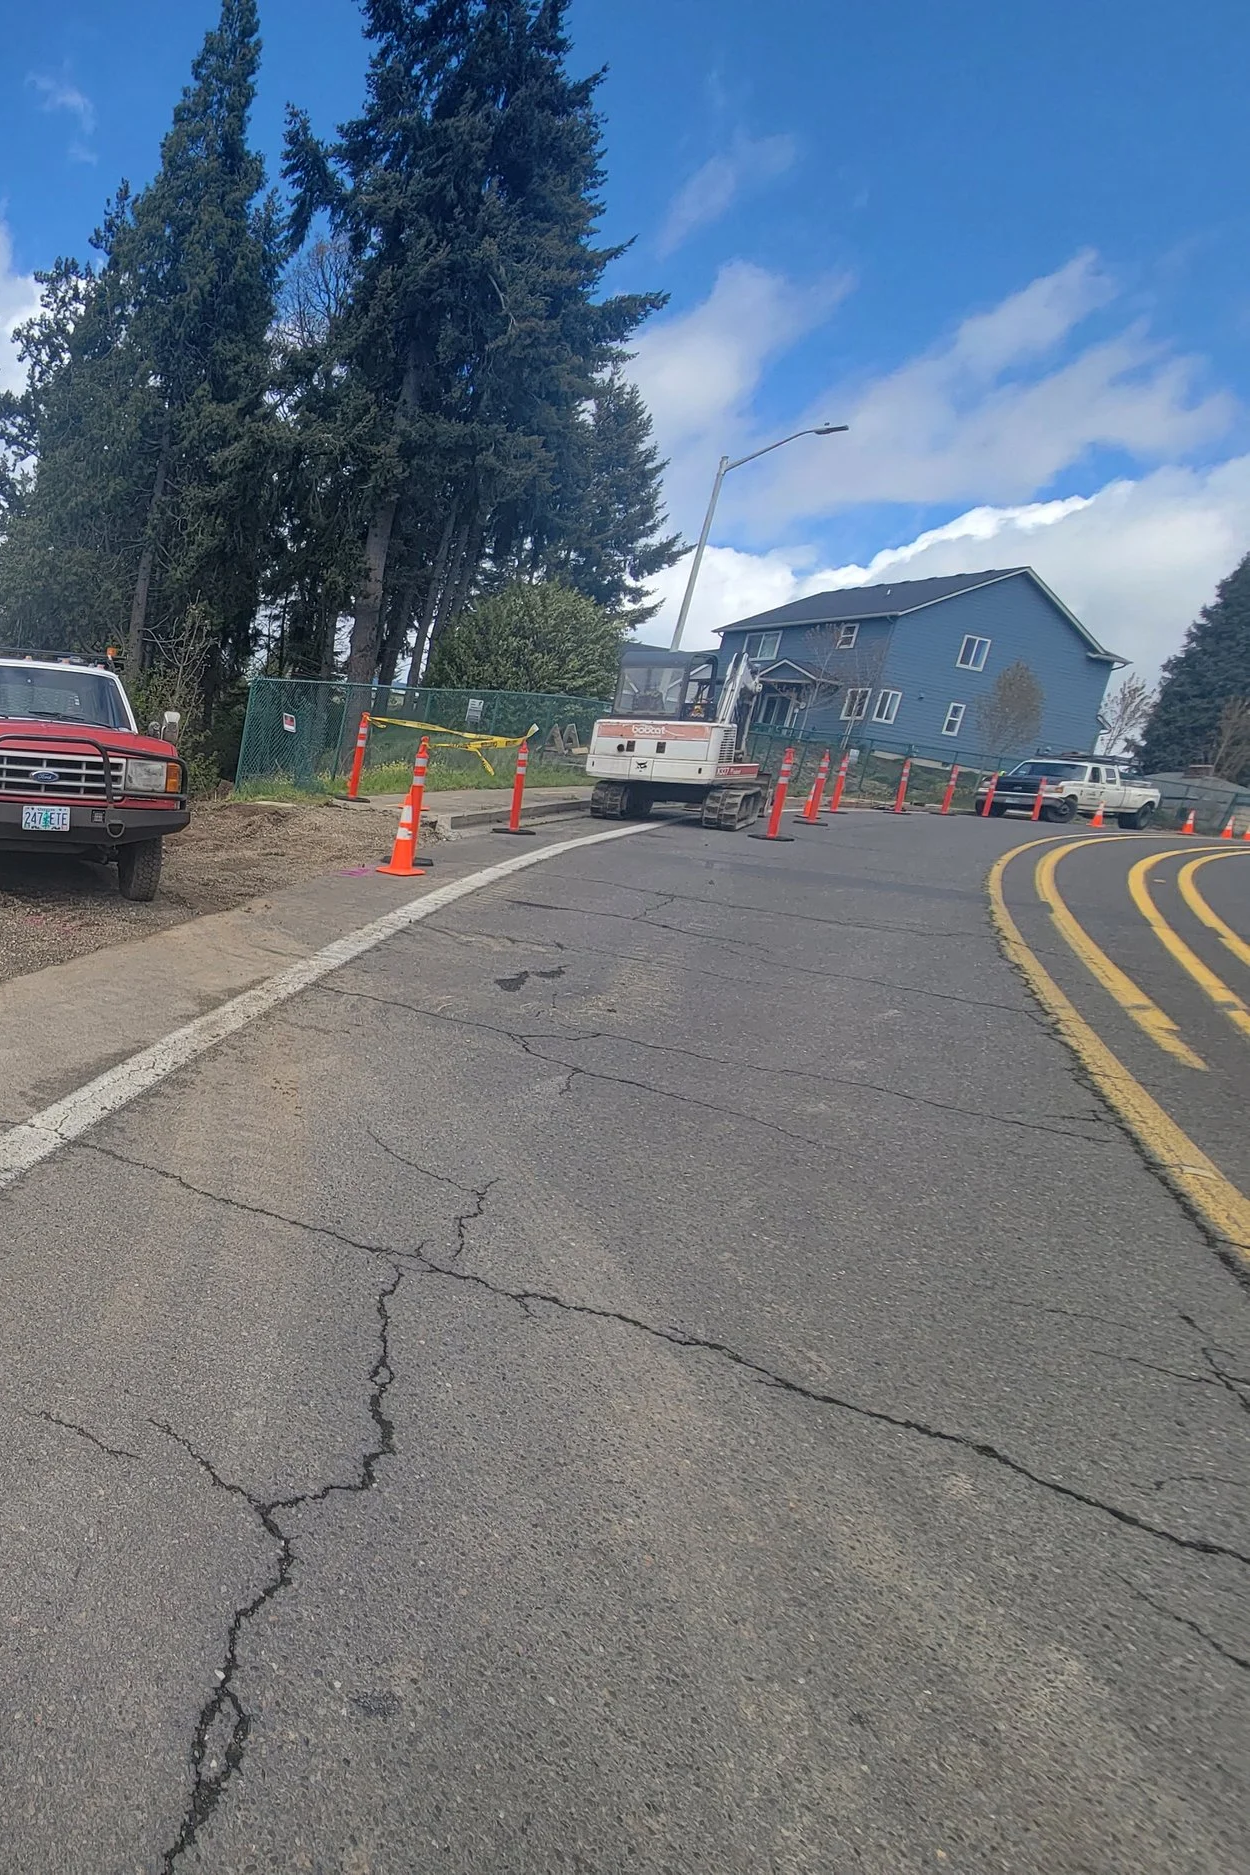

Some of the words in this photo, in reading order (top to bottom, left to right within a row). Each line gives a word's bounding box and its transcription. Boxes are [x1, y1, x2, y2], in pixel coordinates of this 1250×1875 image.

[632, 724, 665, 735] bobcat
[25, 811, 43, 825] 247
[49, 812, 68, 826] ETE
